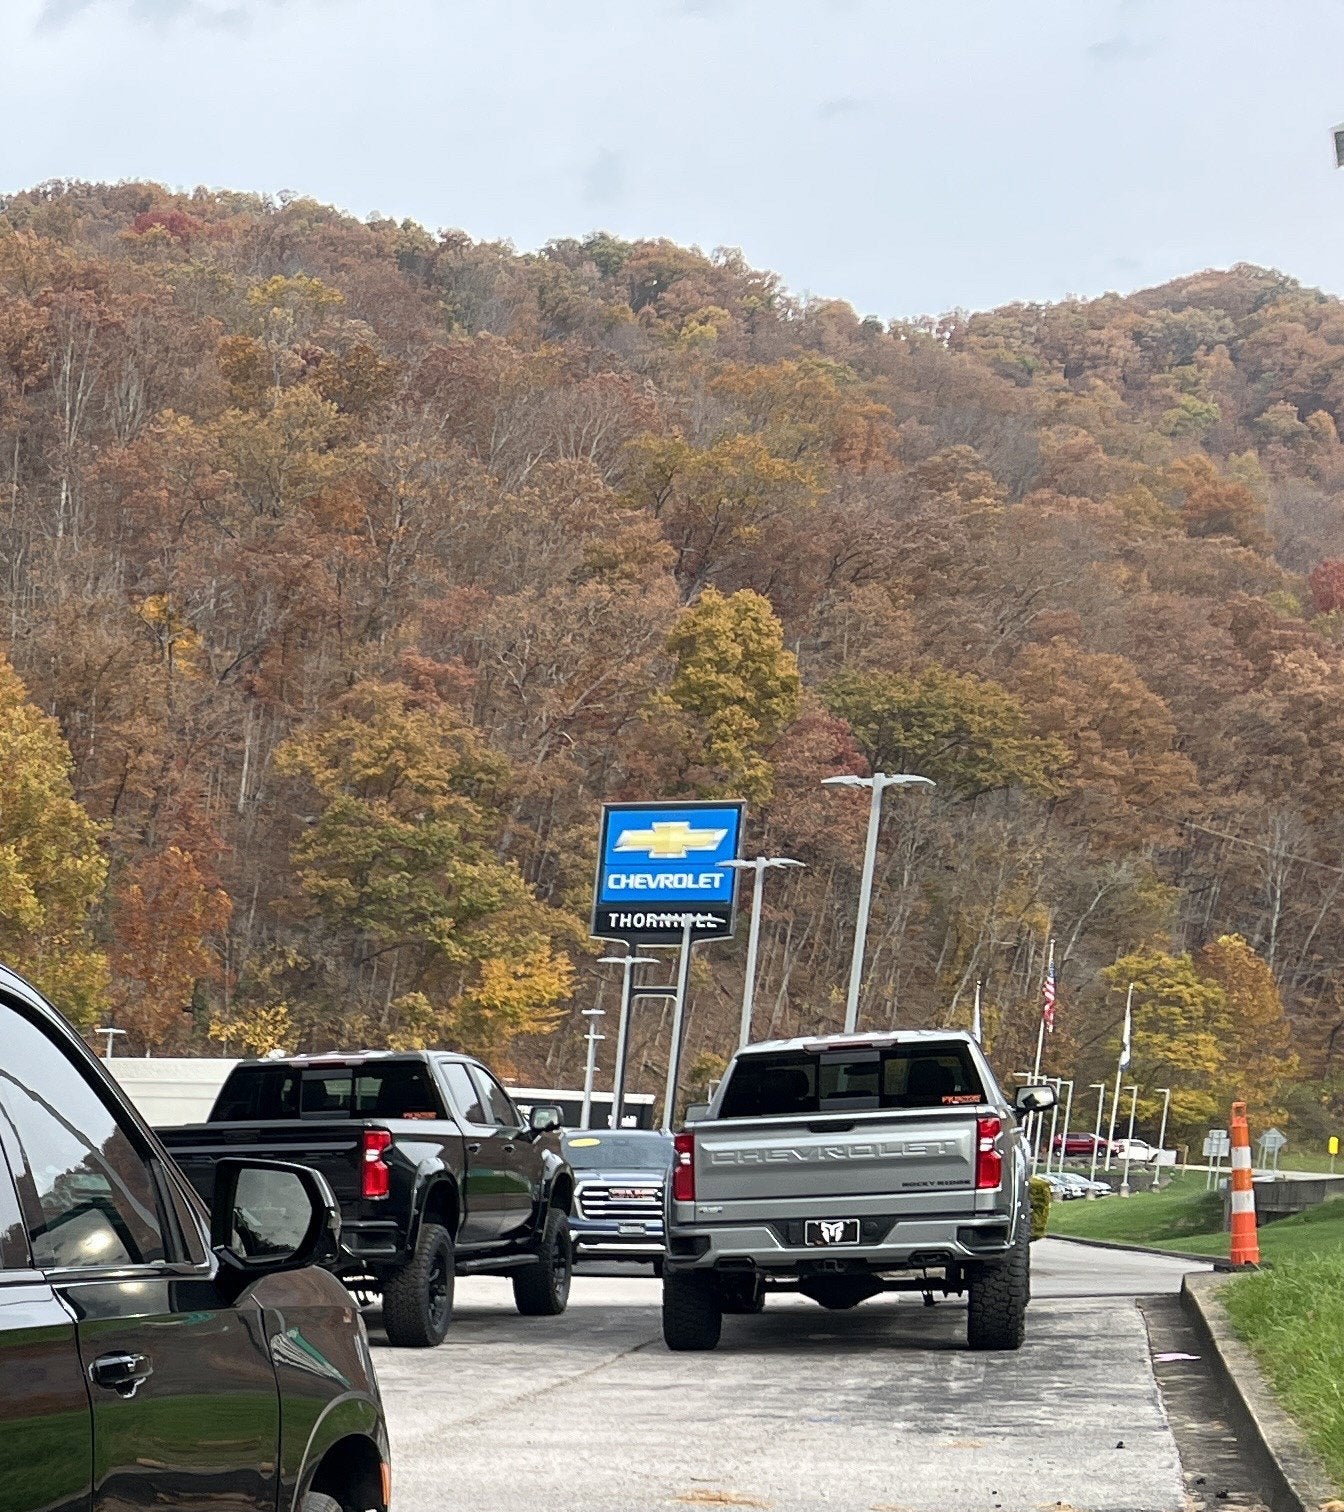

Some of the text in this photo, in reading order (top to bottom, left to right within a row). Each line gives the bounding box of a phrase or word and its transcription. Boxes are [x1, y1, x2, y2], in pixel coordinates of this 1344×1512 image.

[608, 873, 725, 889] CHEVROLET
[609, 912, 718, 928] THORNHLL
[711, 1141, 957, 1165] CHEVROLET
